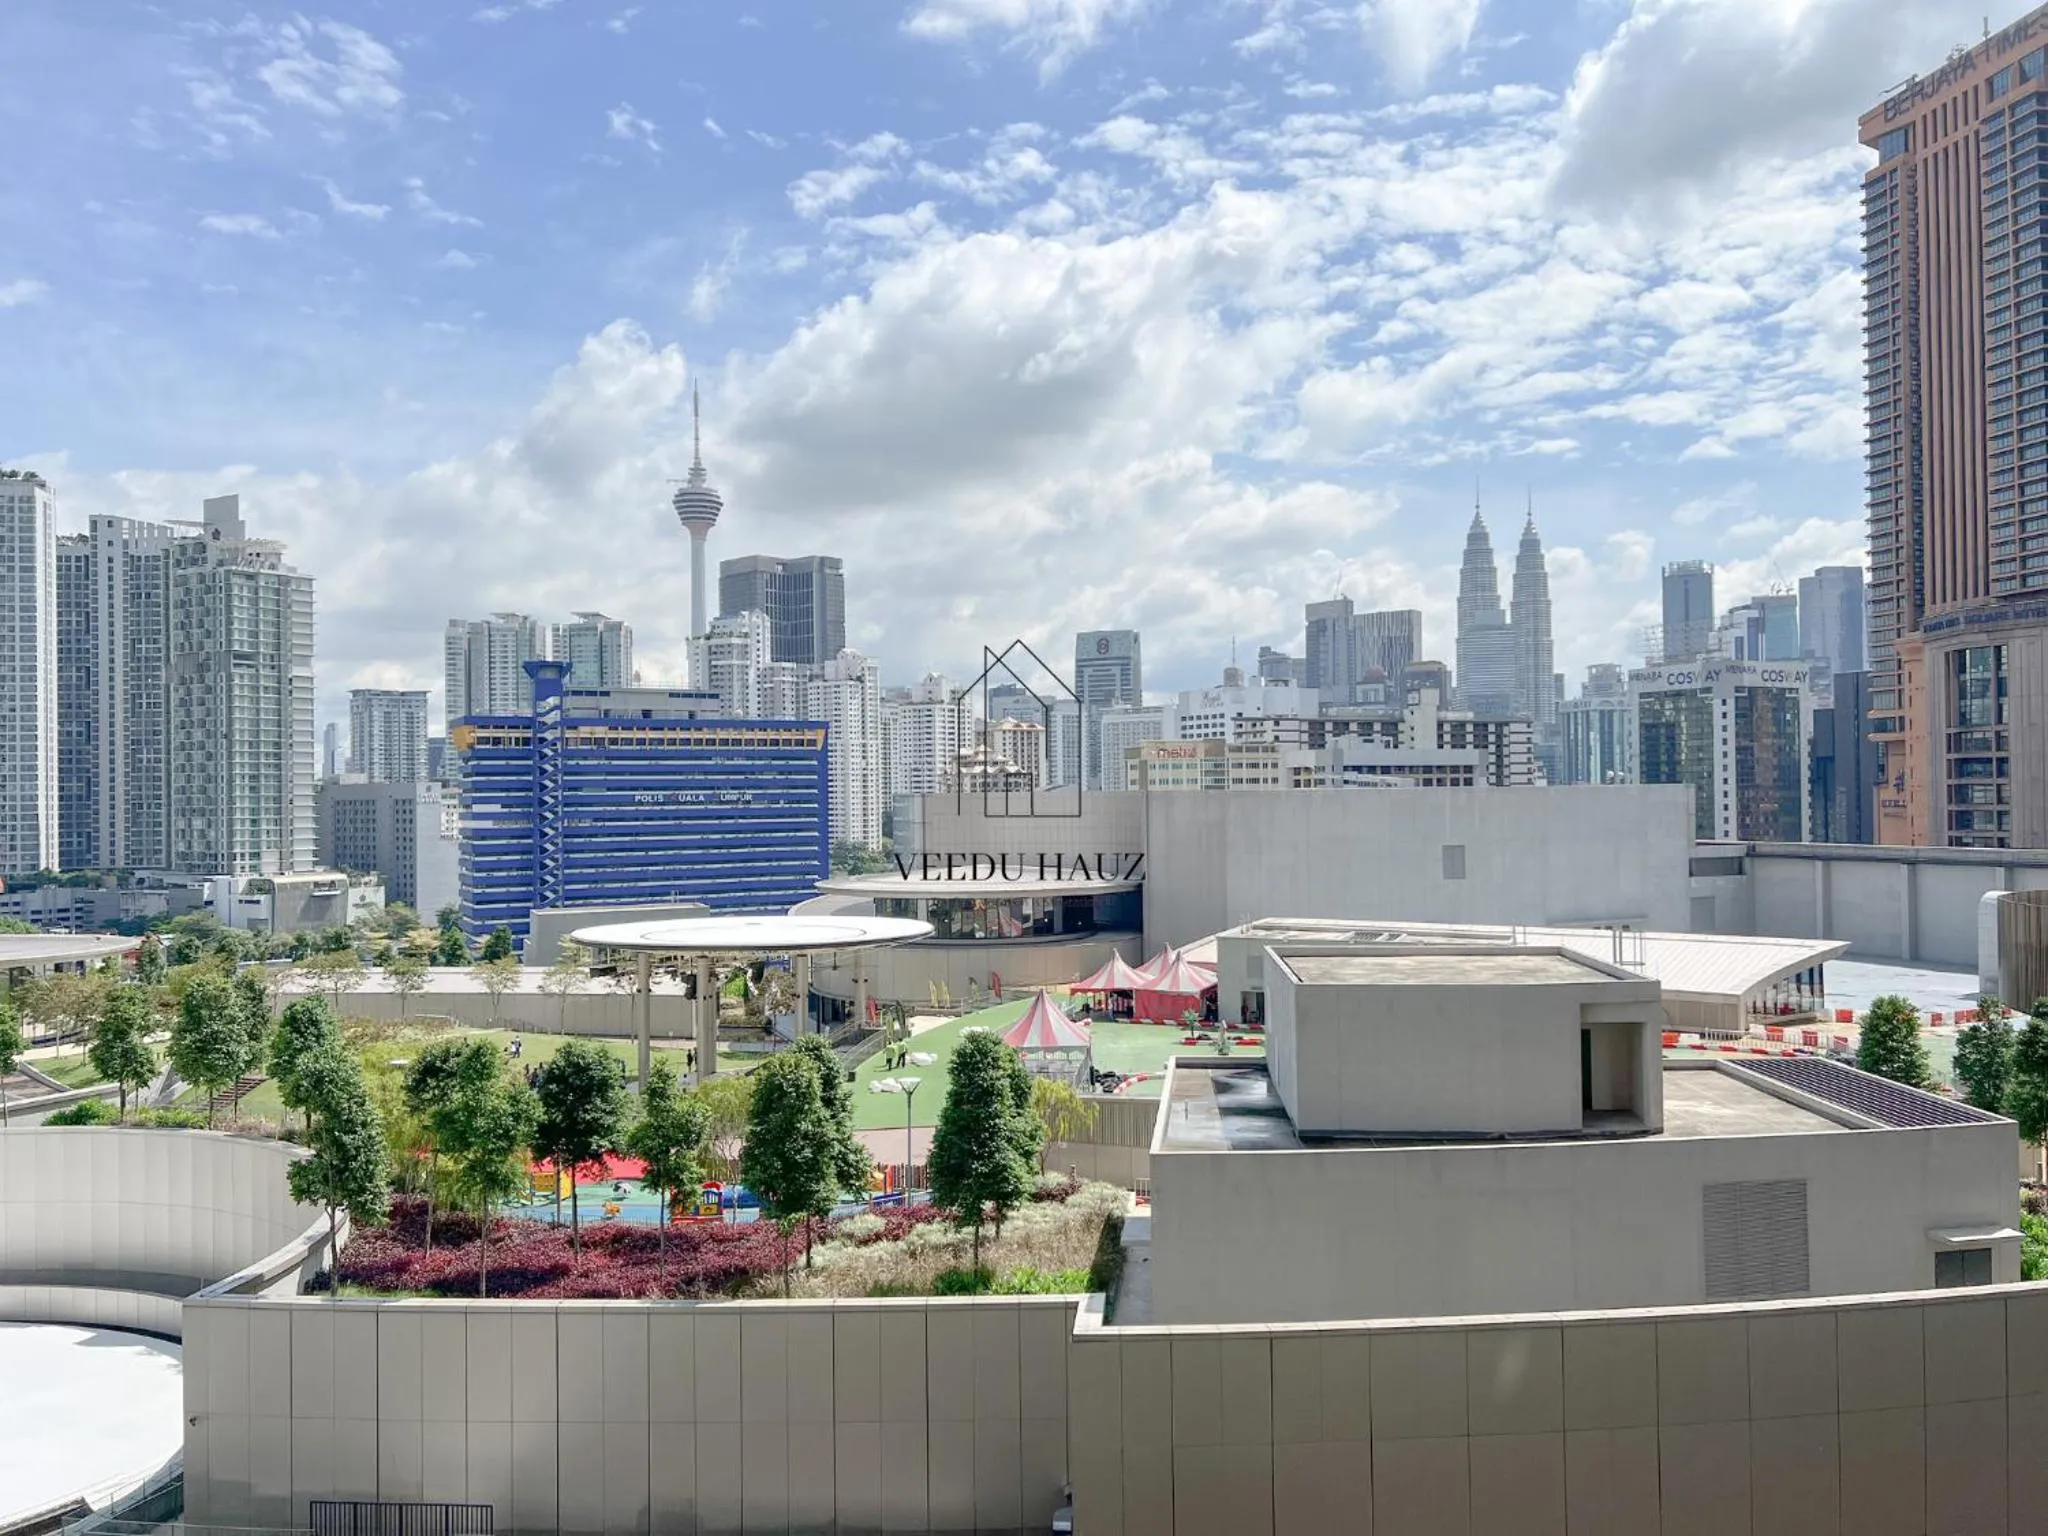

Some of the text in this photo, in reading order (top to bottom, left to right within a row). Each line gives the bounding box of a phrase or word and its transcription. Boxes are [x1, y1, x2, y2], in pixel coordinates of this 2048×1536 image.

[1883, 53, 1977, 122] BERJAYA
[634, 794, 664, 803] POLIS
[713, 792, 753, 802] UMPUR
